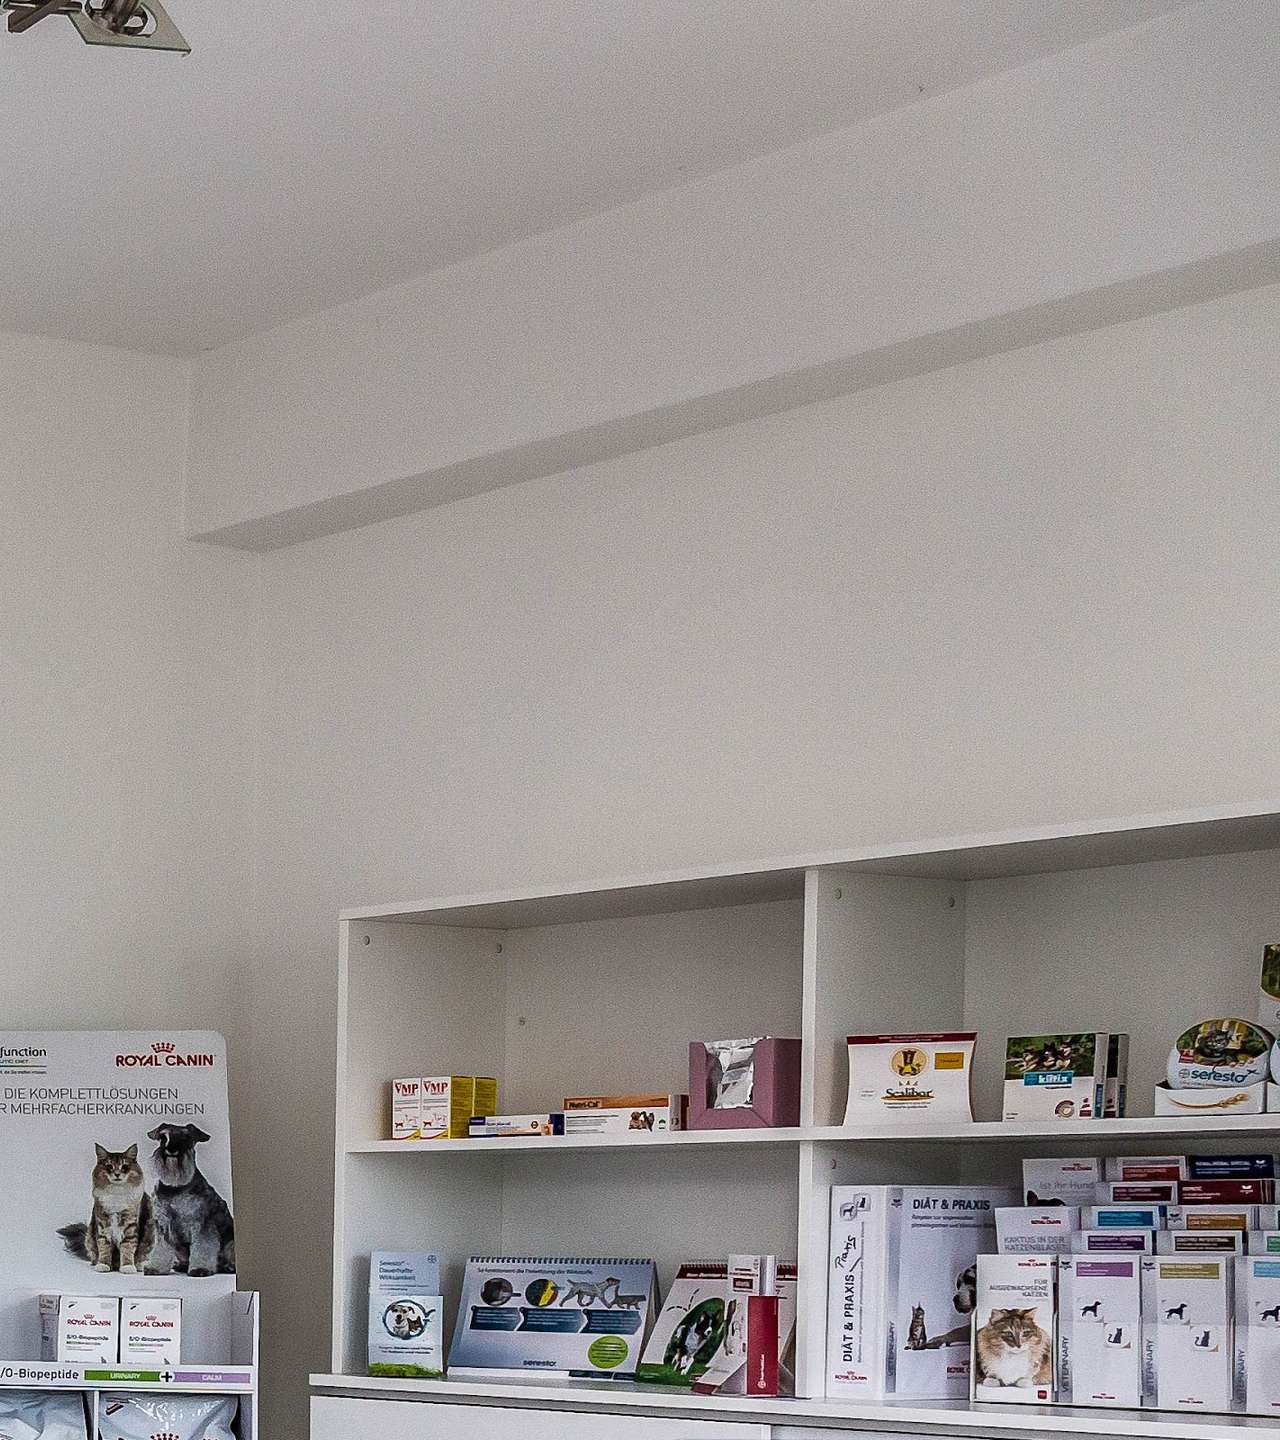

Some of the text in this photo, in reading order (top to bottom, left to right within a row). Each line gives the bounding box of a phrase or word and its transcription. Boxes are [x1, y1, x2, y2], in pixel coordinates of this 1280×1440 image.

[116, 1054, 214, 1067] ROYAL CANIN
[1191, 1070, 1246, 1083] seresto
[4, 1086, 178, 1100] DIE KOMPLETTLÖSUNGEN
[395, 1083, 419, 1094] VMP
[423, 1082, 448, 1093] VMP
[10, 1103, 204, 1115] MEHRFACHERKRANKUNGEN
[913, 1197, 990, 1210] DIÄT & PRAXIS
[843, 1274, 855, 1362] DIÄT & PRAXIS
